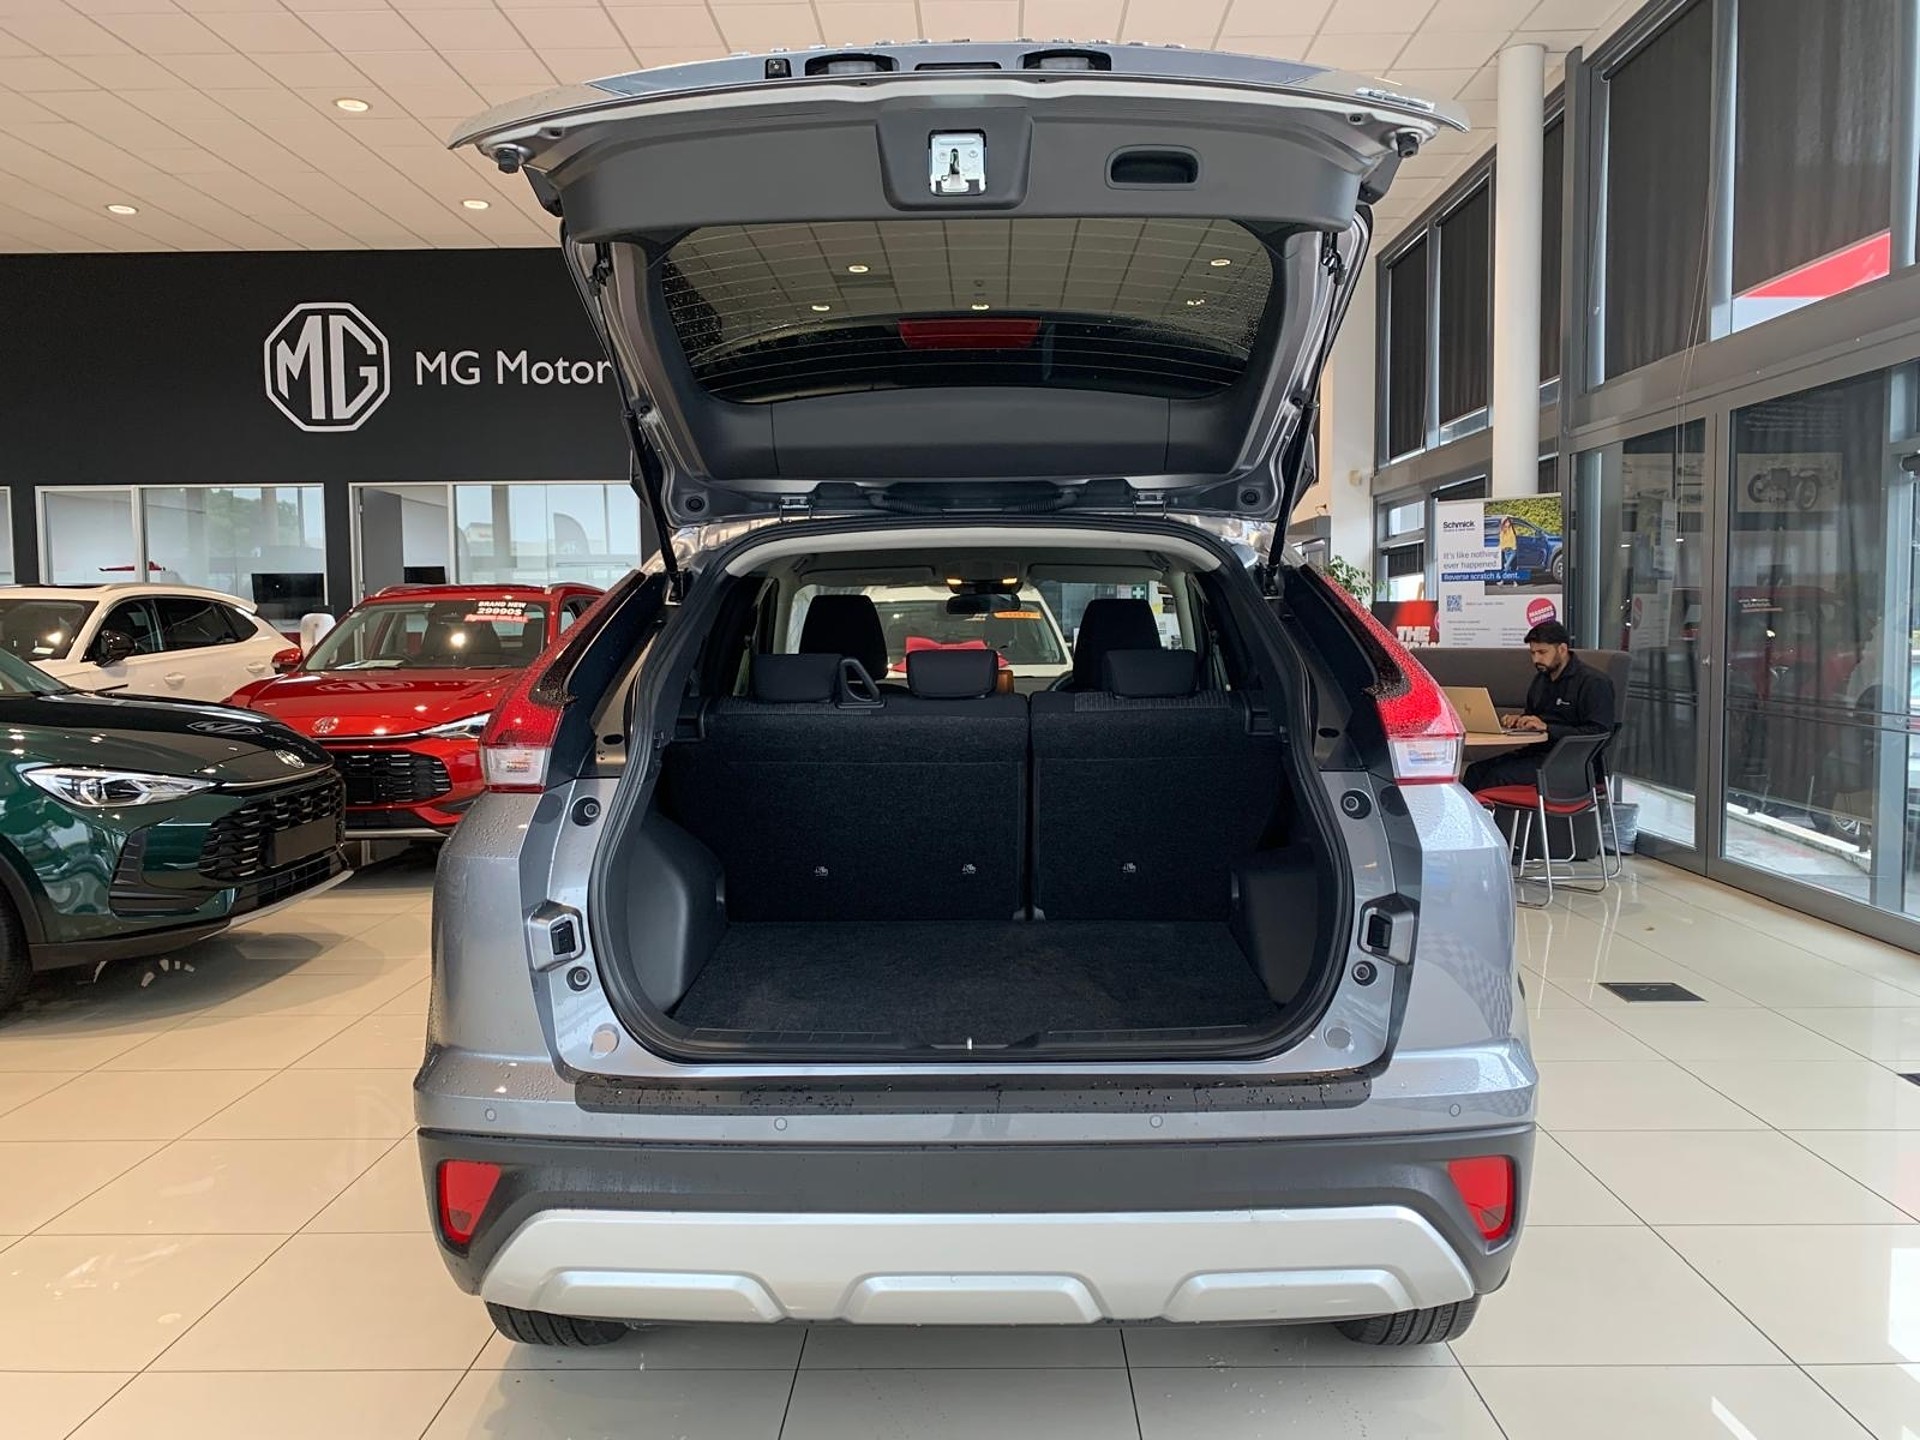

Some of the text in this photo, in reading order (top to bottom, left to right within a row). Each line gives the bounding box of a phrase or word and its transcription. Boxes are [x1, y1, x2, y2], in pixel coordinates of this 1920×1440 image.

[276, 314, 379, 420] MG
[415, 350, 612, 385] MG Motor
[1443, 521, 1475, 529] Schmick
[1397, 626, 1431, 642] THE
